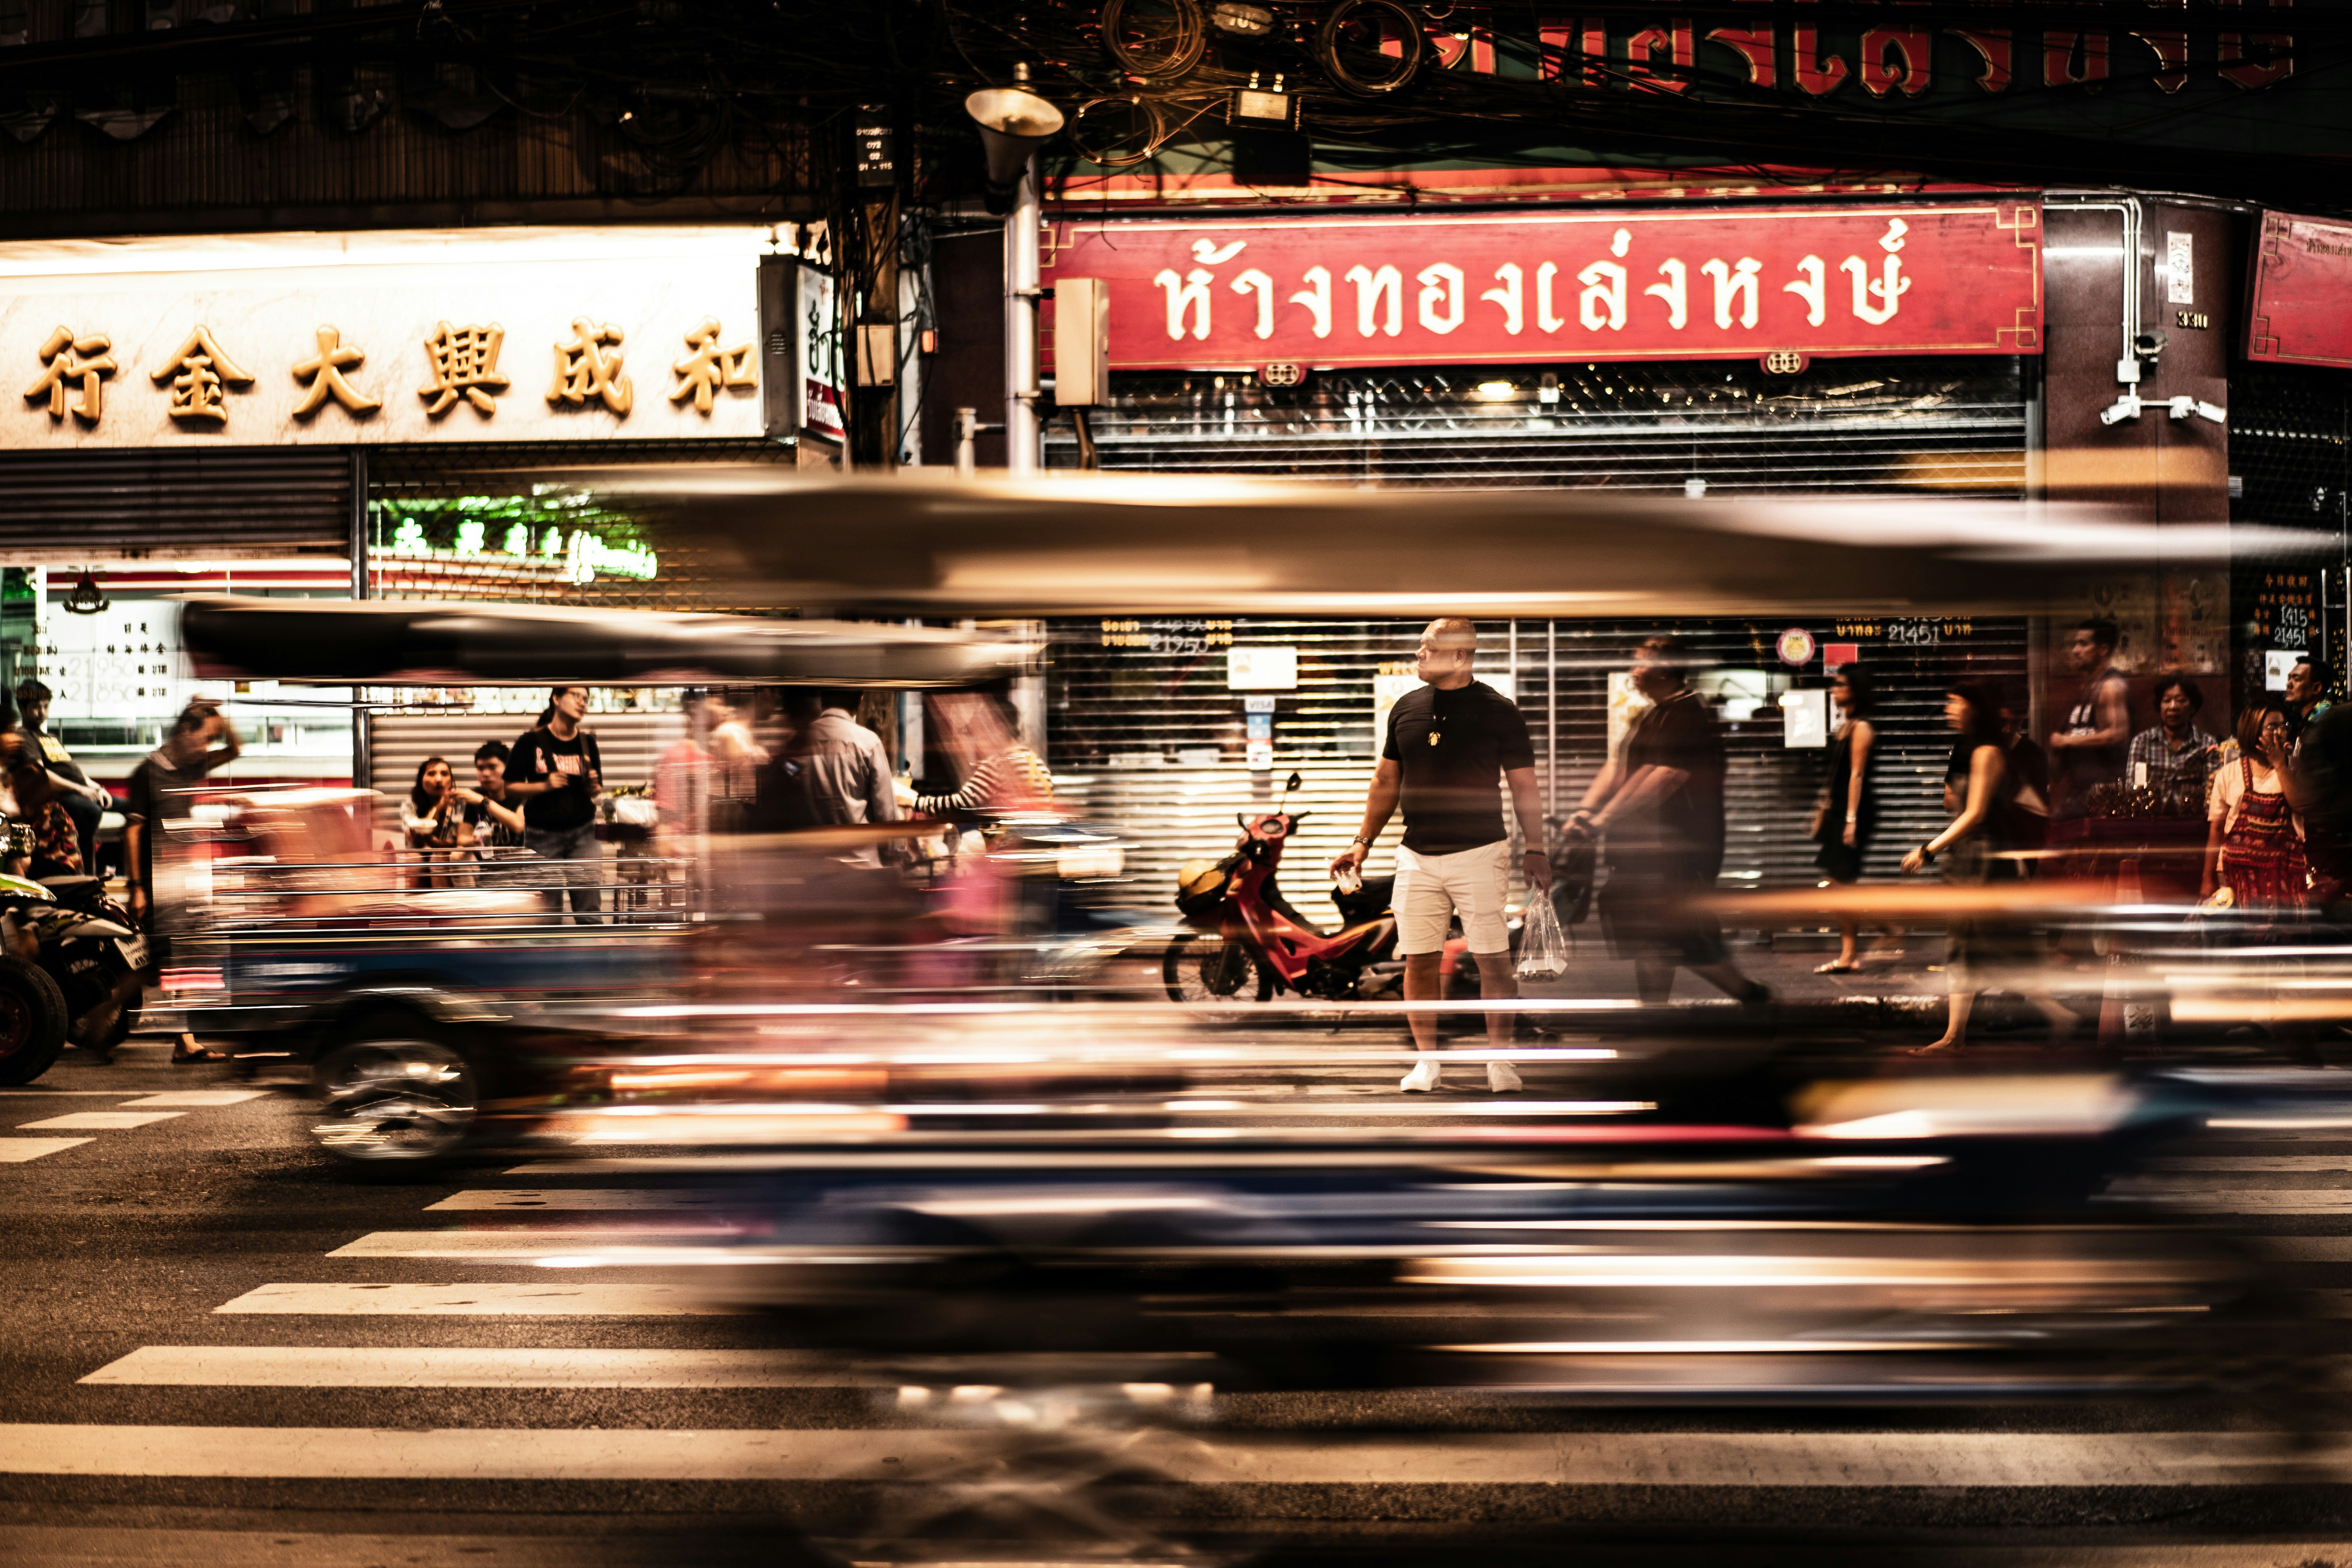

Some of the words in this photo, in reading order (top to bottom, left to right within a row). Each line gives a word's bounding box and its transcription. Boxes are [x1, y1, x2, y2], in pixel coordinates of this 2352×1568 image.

[1154, 218, 1911, 341] ห้างทองเล่งหงษ์
[1250, 700, 1272, 709] VISA
